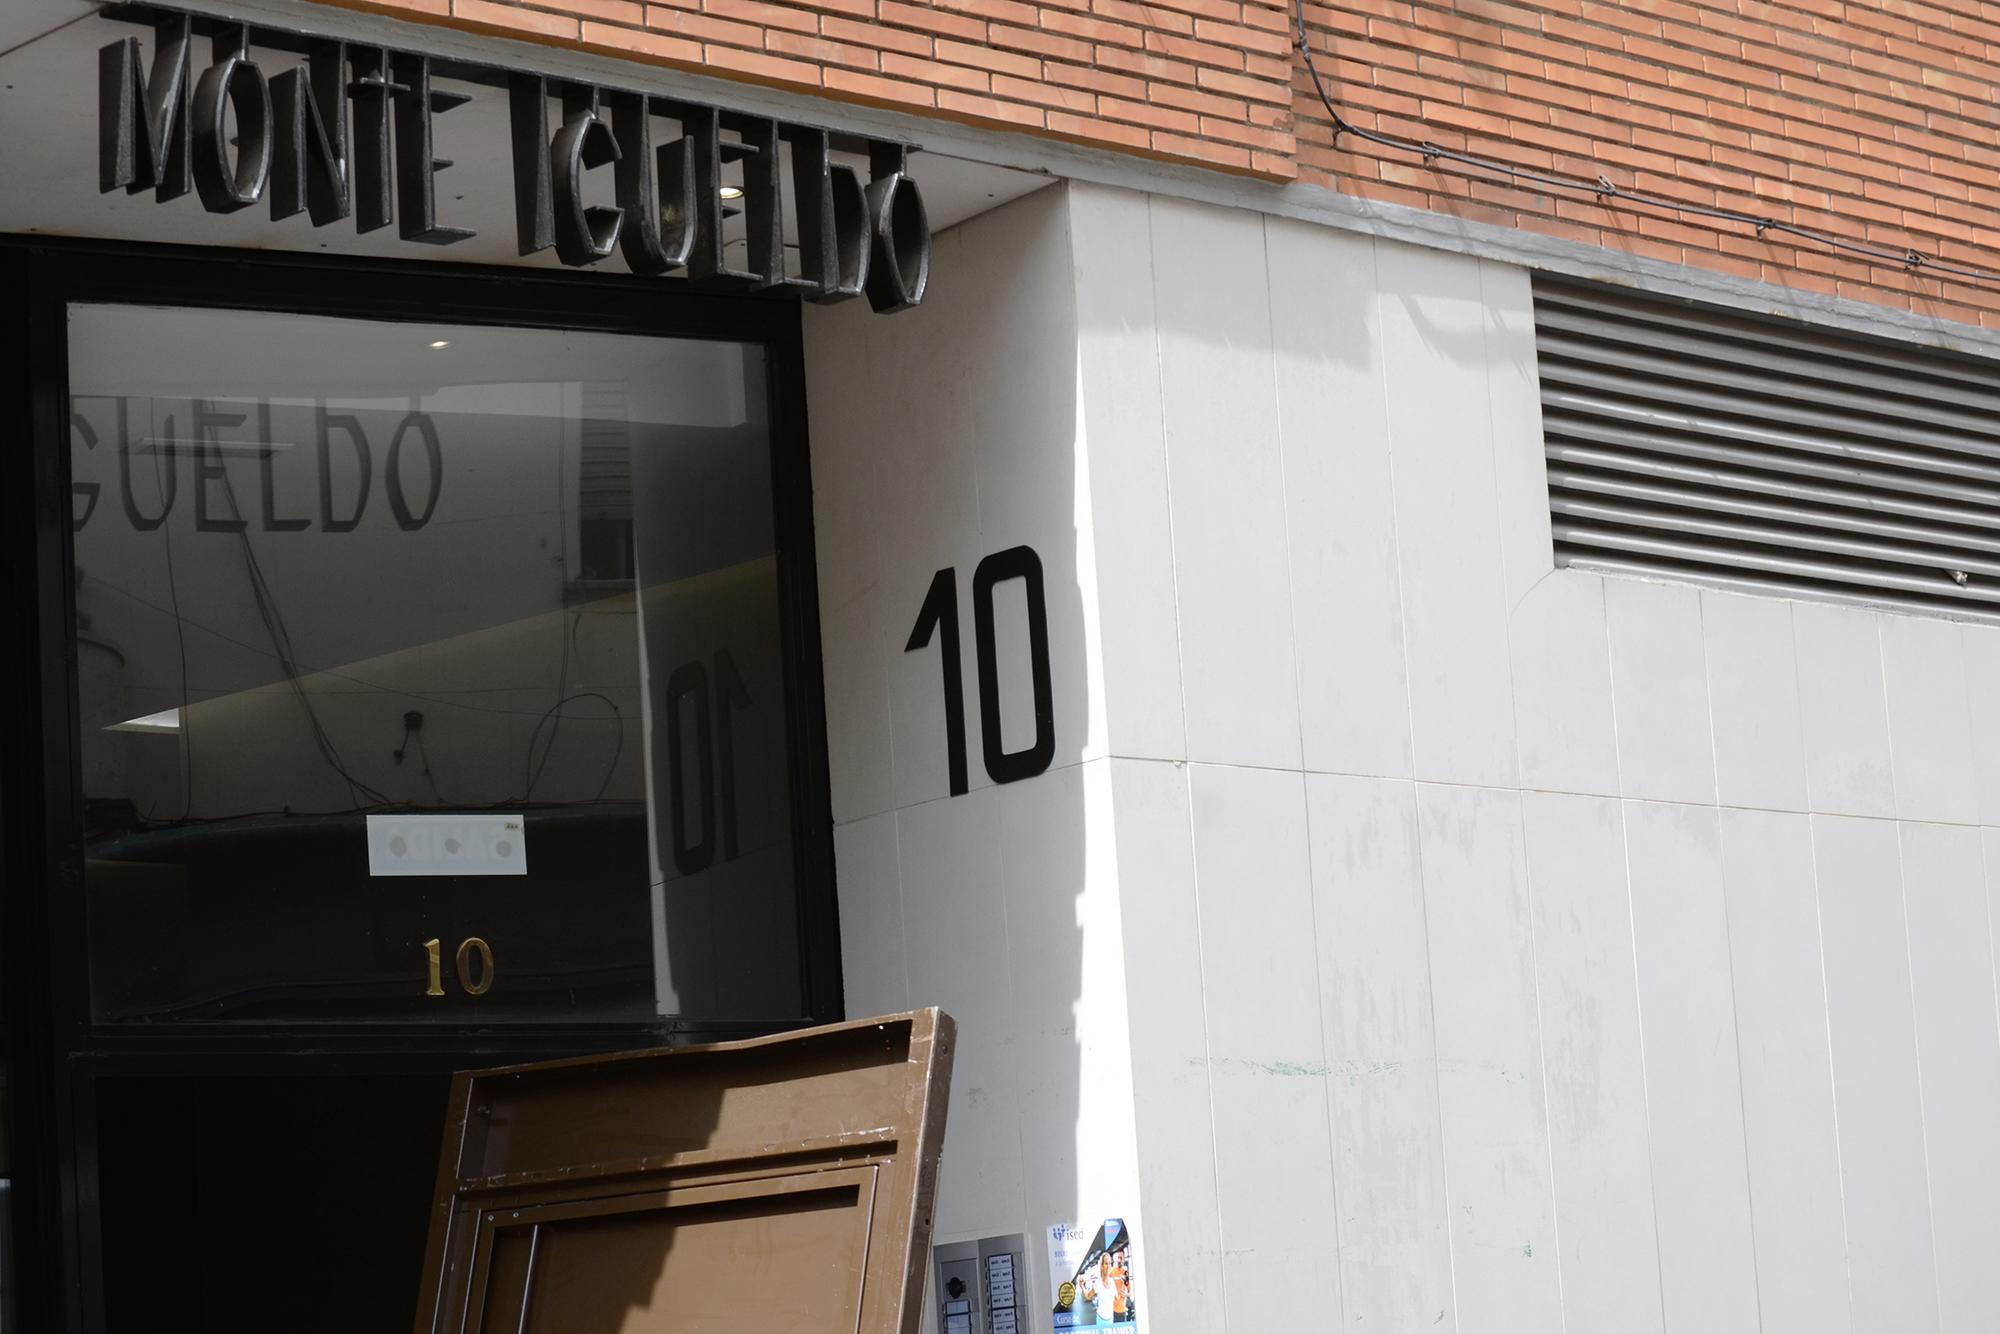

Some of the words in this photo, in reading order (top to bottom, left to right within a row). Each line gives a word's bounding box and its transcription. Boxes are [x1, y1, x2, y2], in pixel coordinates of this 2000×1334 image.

[99, 14, 479, 245] MONTE
[508, 72, 932, 315] IGUELDO
[904, 545, 1056, 798] 10
[423, 937, 495, 996] 10
